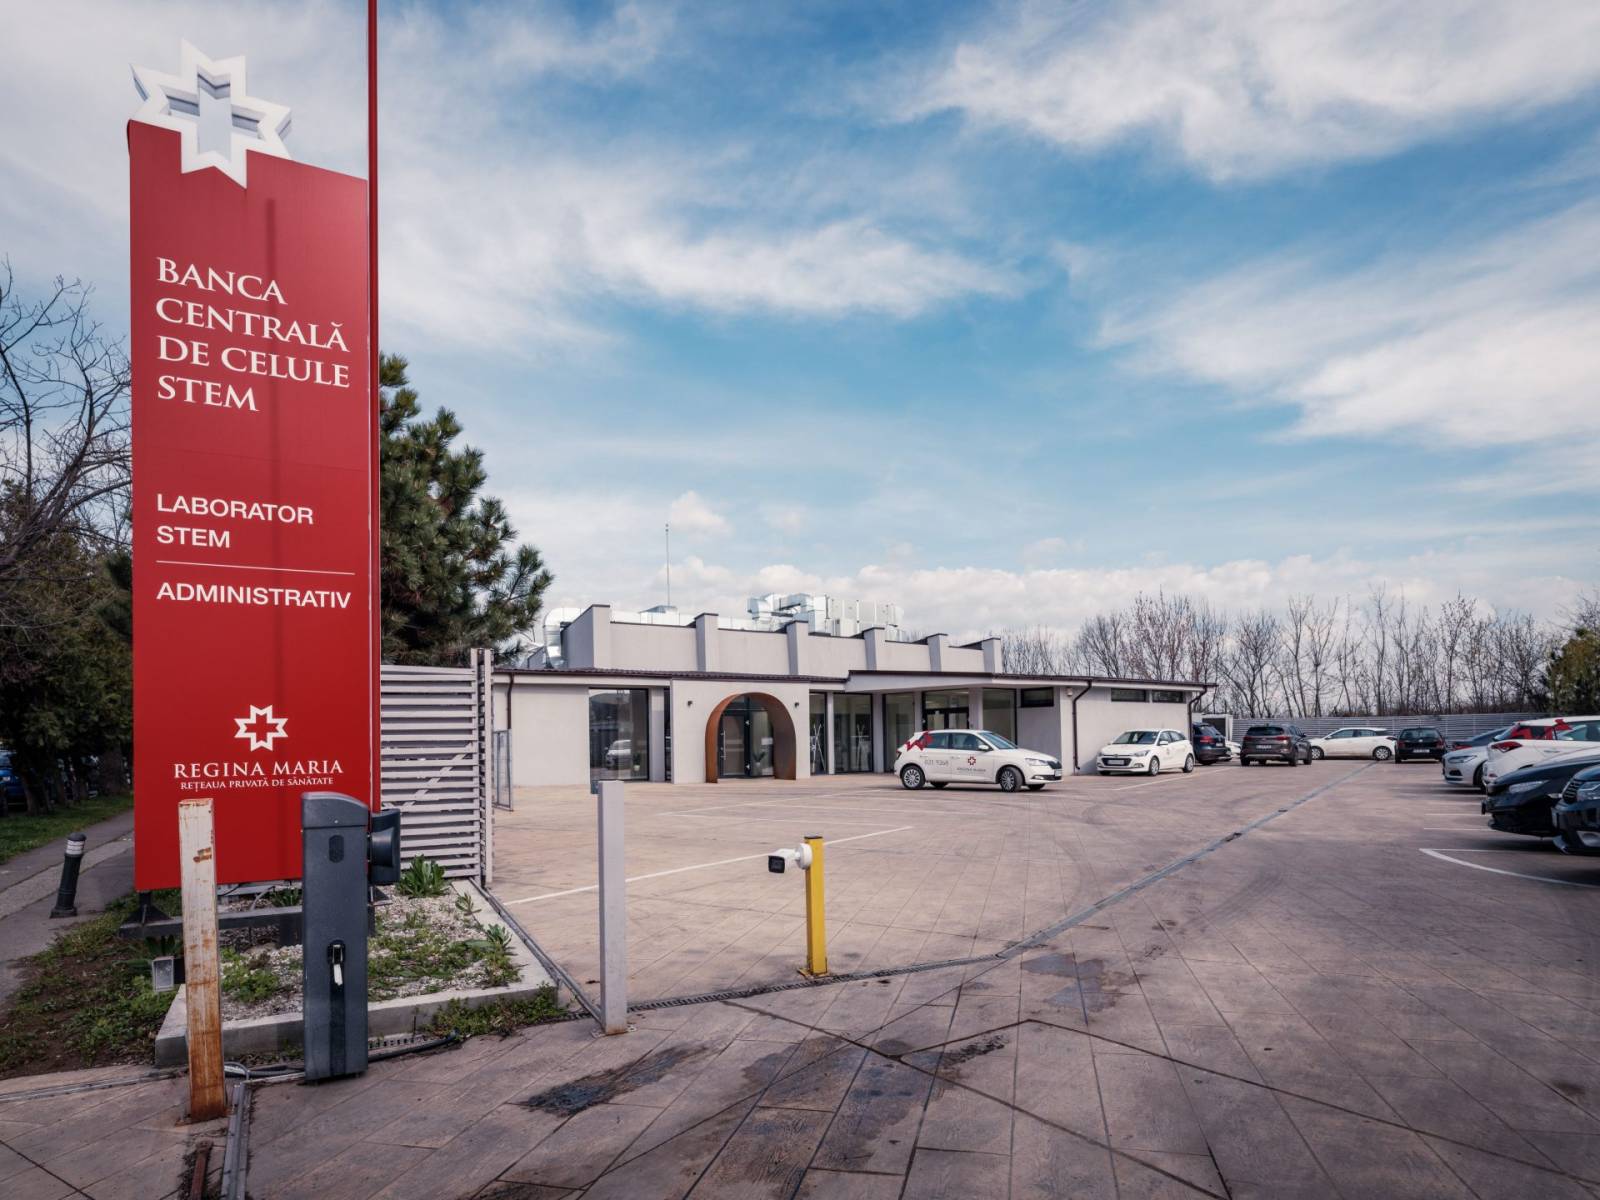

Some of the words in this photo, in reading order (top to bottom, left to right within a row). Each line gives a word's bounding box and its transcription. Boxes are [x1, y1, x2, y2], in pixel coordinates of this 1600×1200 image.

[157, 257, 287, 305] BANCA
[155, 297, 351, 353] CENTRALĂ
[157, 335, 210, 367] DE
[220, 346, 350, 389] CELULE
[157, 375, 259, 411] STEM
[156, 493, 314, 524] LABORATOR
[156, 525, 231, 549] STEM
[156, 582, 351, 608] ADMINISTRATIV
[173, 762, 265, 779] REGINA
[273, 759, 344, 776] MARIA
[229, 778, 269, 788] PRIVATĂ
[271, 779, 285, 787] DE
[287, 776, 334, 786] SĂNĂTATE
